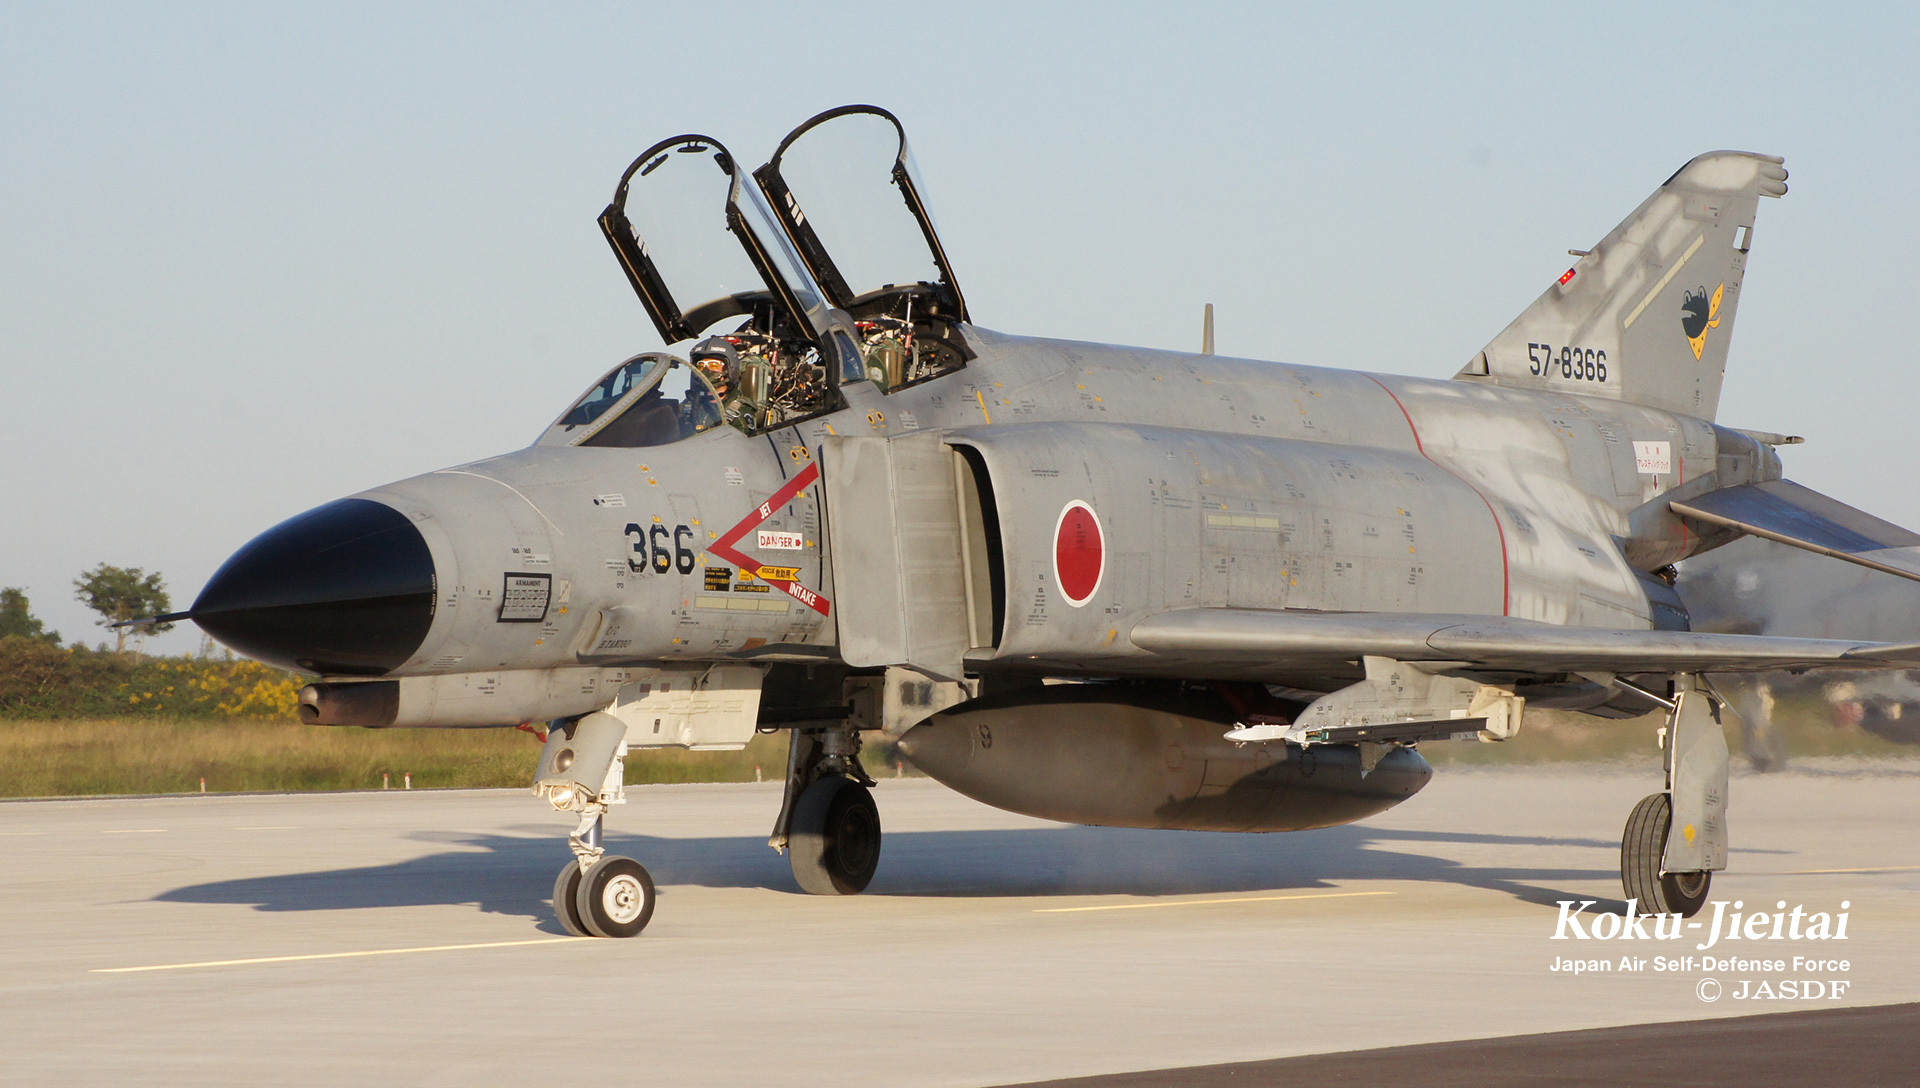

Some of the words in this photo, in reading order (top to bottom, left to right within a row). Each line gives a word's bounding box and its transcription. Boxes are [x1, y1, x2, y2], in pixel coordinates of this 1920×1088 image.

[1528, 343, 1607, 382] 57-8366
[759, 502, 772, 519] JET
[624, 523, 695, 575] 366
[760, 535, 793, 548] DANGER
[789, 582, 818, 606] INTAKE
